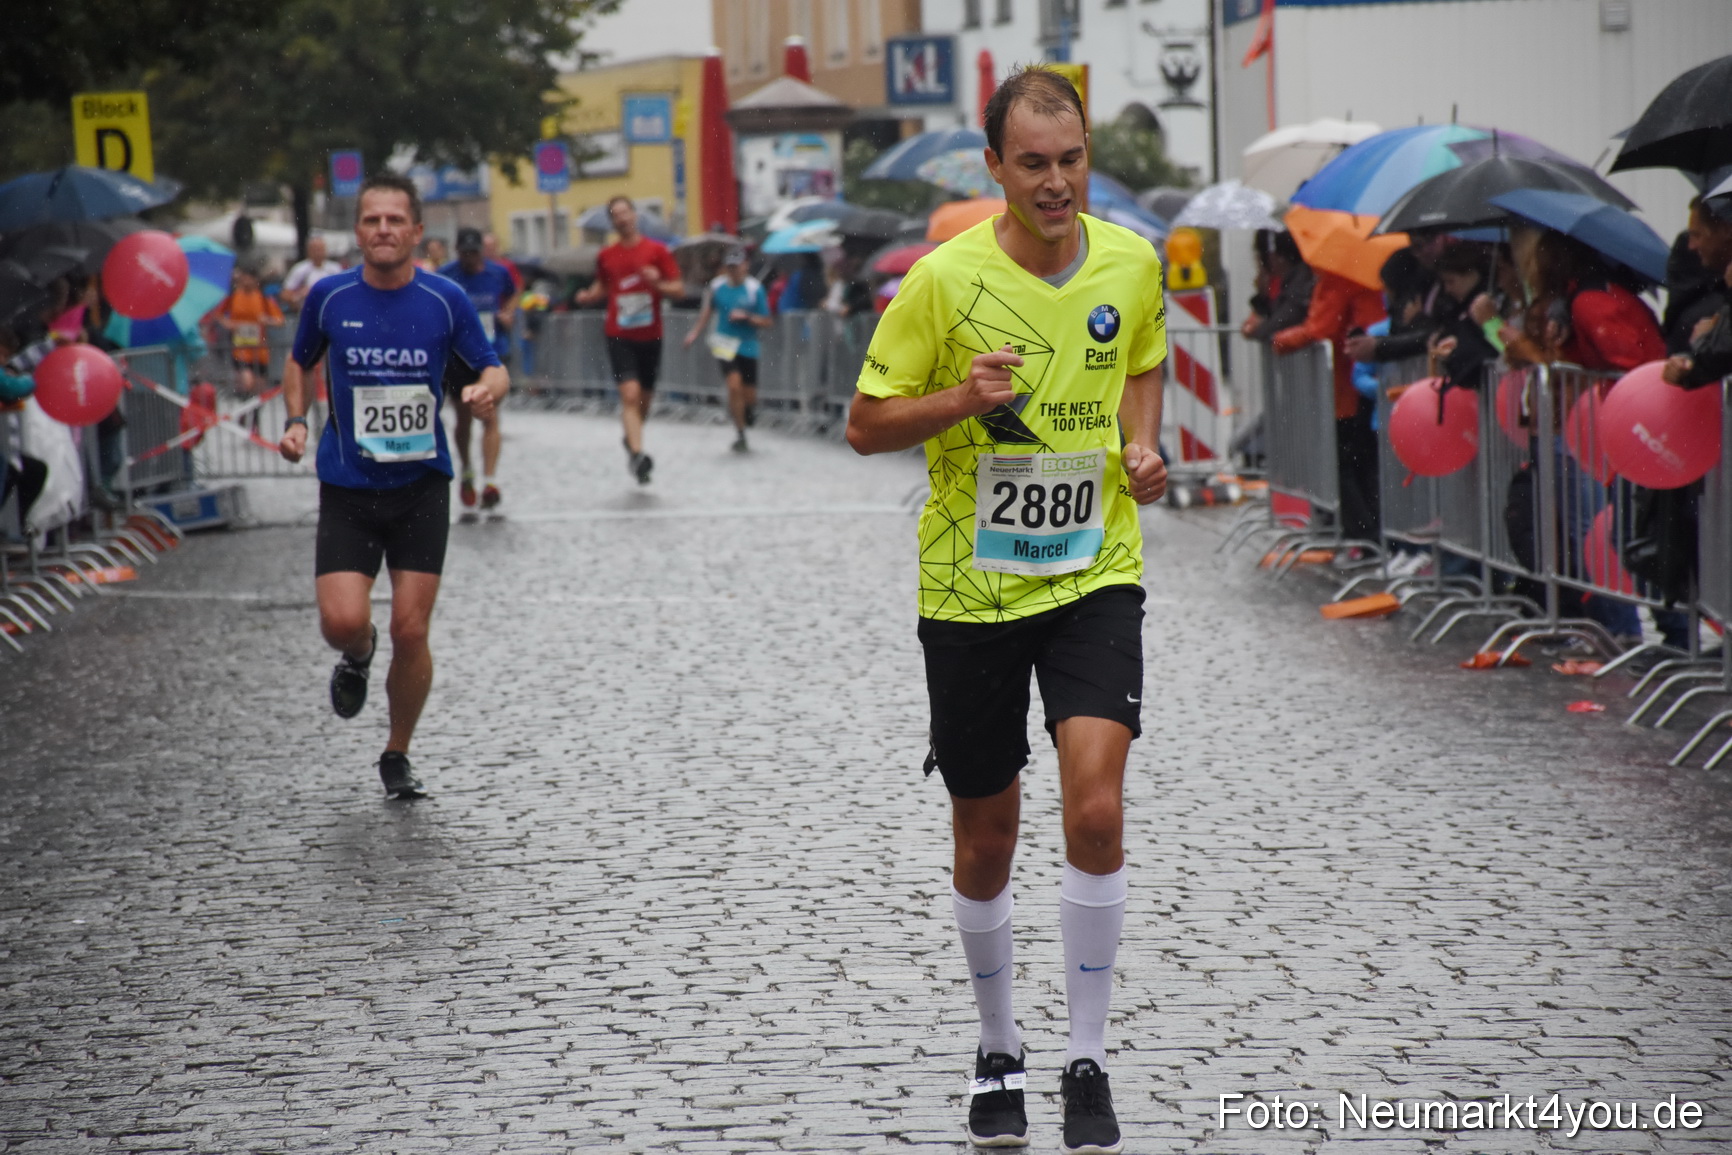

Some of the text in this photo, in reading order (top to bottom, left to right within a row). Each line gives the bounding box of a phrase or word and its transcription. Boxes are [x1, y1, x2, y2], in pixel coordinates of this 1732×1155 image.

[83, 98, 139, 119] Block
[96, 128, 133, 171] D
[1090, 305, 1119, 318] BMW
[346, 347, 428, 366] SYSCAD
[1085, 347, 1118, 362] Partl
[1085, 363, 1116, 371] Neumarkt
[1040, 401, 1102, 417] THE NEXT
[364, 403, 428, 433] 2568
[1052, 415, 1112, 431] 100 YEARS
[385, 440, 411, 452] Marc
[990, 466, 1034, 474] NeuerMarkt
[1041, 454, 1098, 472] BOCK
[991, 480, 1094, 529] 2880
[981, 520, 987, 528] D
[1014, 538, 1069, 559] Marcel
